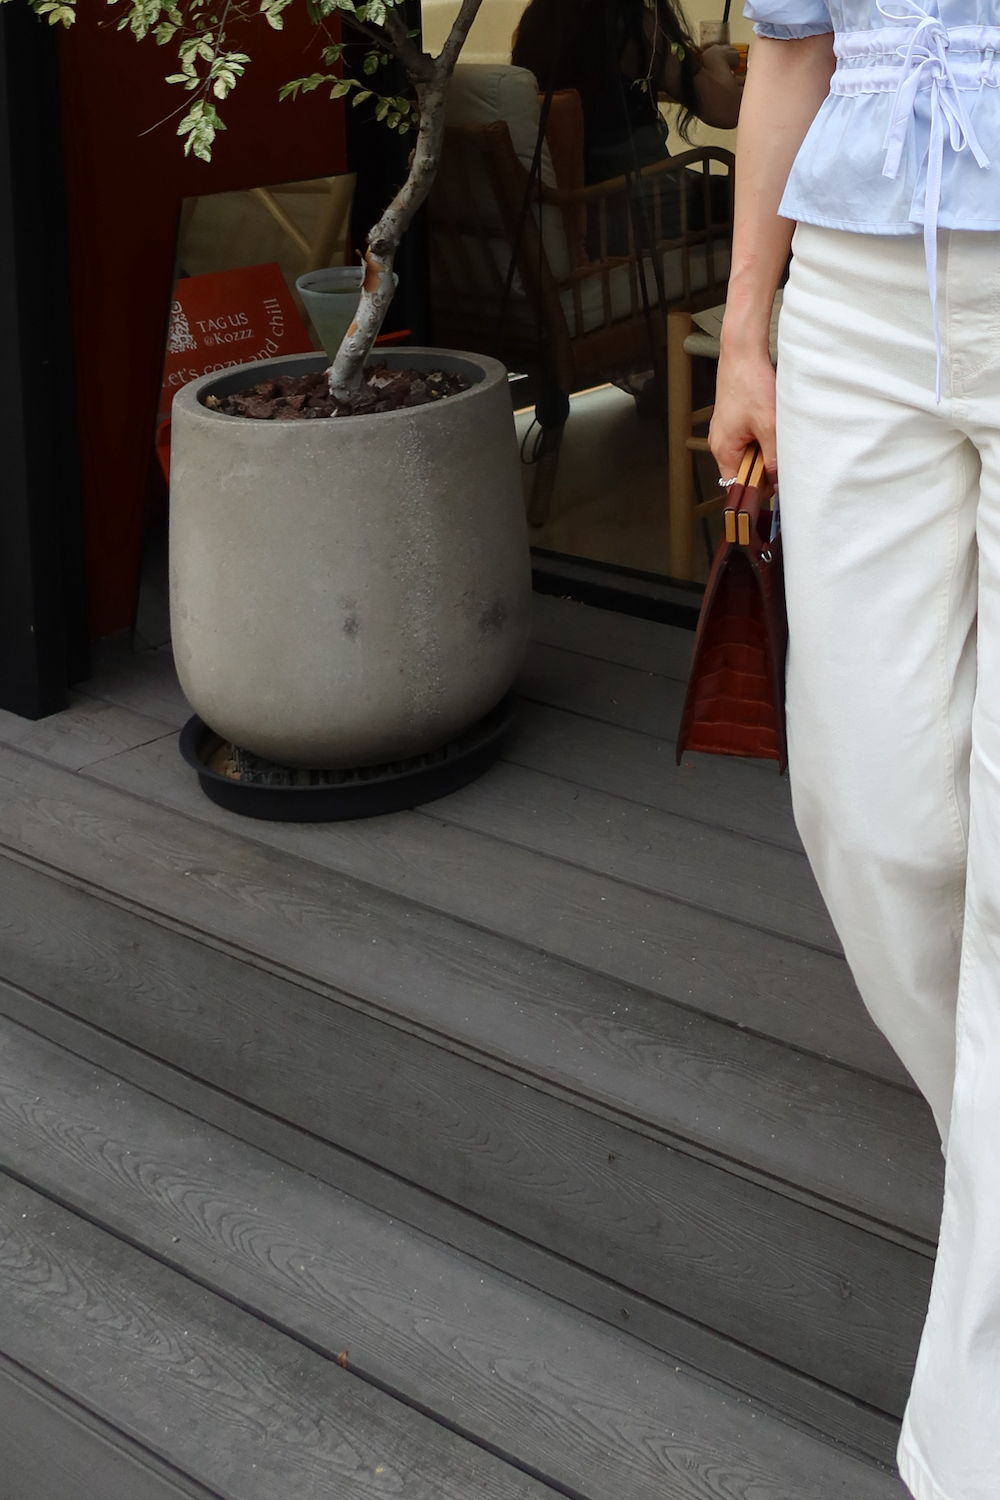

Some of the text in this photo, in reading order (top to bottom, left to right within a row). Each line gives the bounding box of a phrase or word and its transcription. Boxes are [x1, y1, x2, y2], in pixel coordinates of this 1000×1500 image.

[196, 312, 249, 333] TAG US
[263, 297, 285, 337] chill
